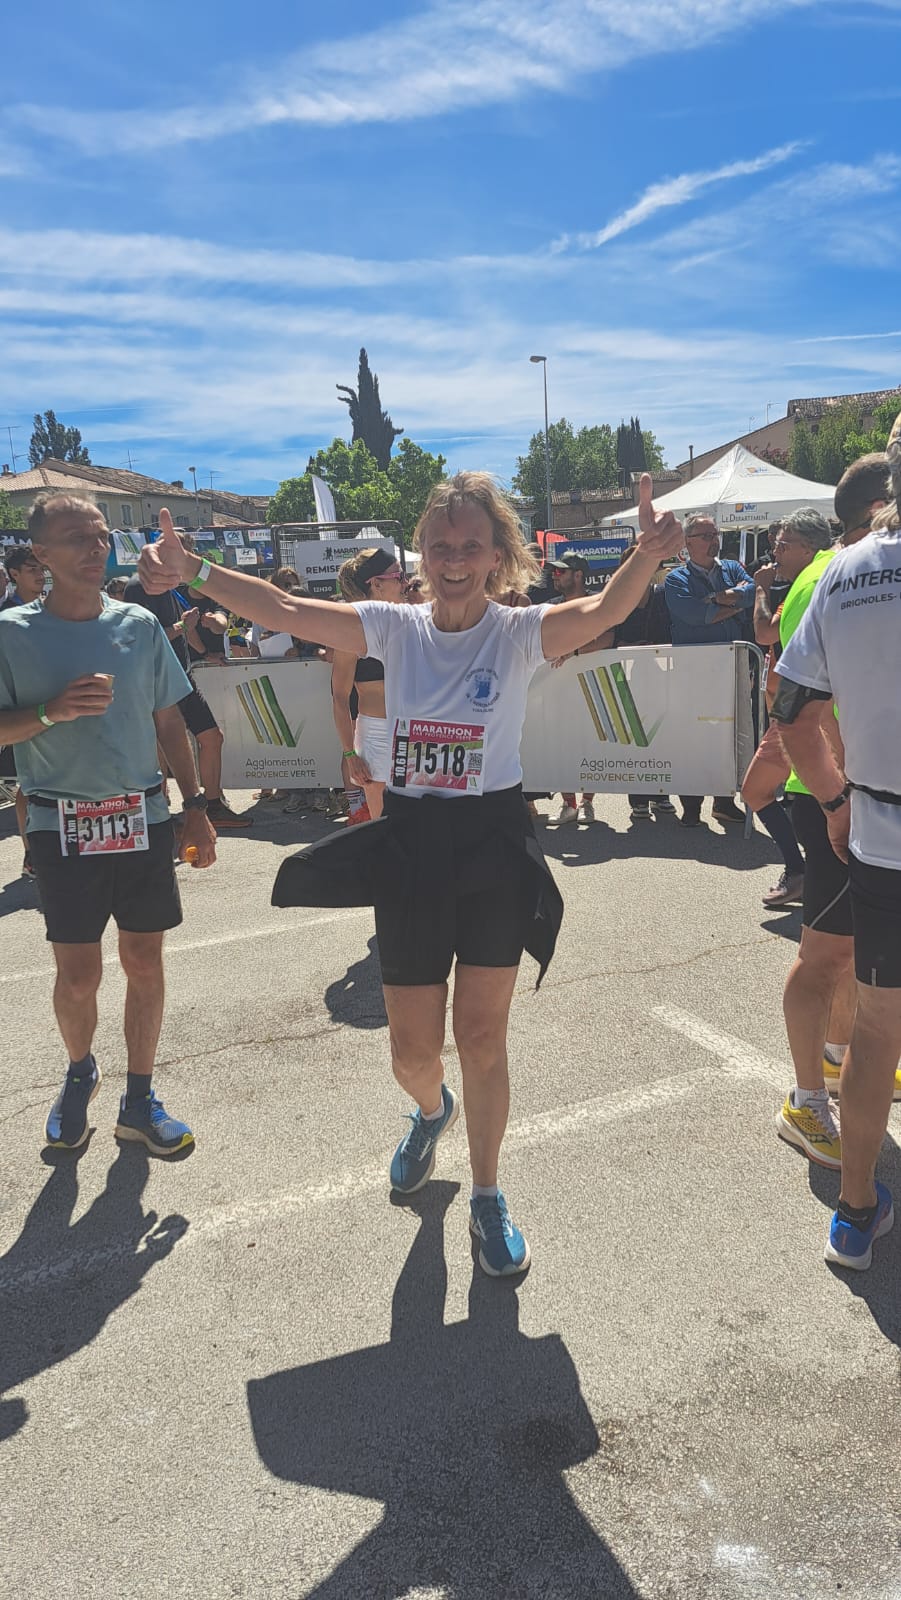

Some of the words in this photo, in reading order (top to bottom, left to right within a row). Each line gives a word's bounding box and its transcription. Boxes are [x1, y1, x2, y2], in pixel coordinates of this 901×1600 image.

[412, 724, 473, 737] MARATHON
[398, 741, 408, 757] km
[413, 741, 466, 777] 1518
[580, 757, 672, 772] Agglomération
[246, 770, 289, 779] PROVENCE
[290, 769, 316, 778] VERTE
[580, 772, 635, 782] PROVENCE
[636, 773, 672, 782] VERTE
[81, 813, 130, 842] 3113
[67, 832, 78, 844] 21
